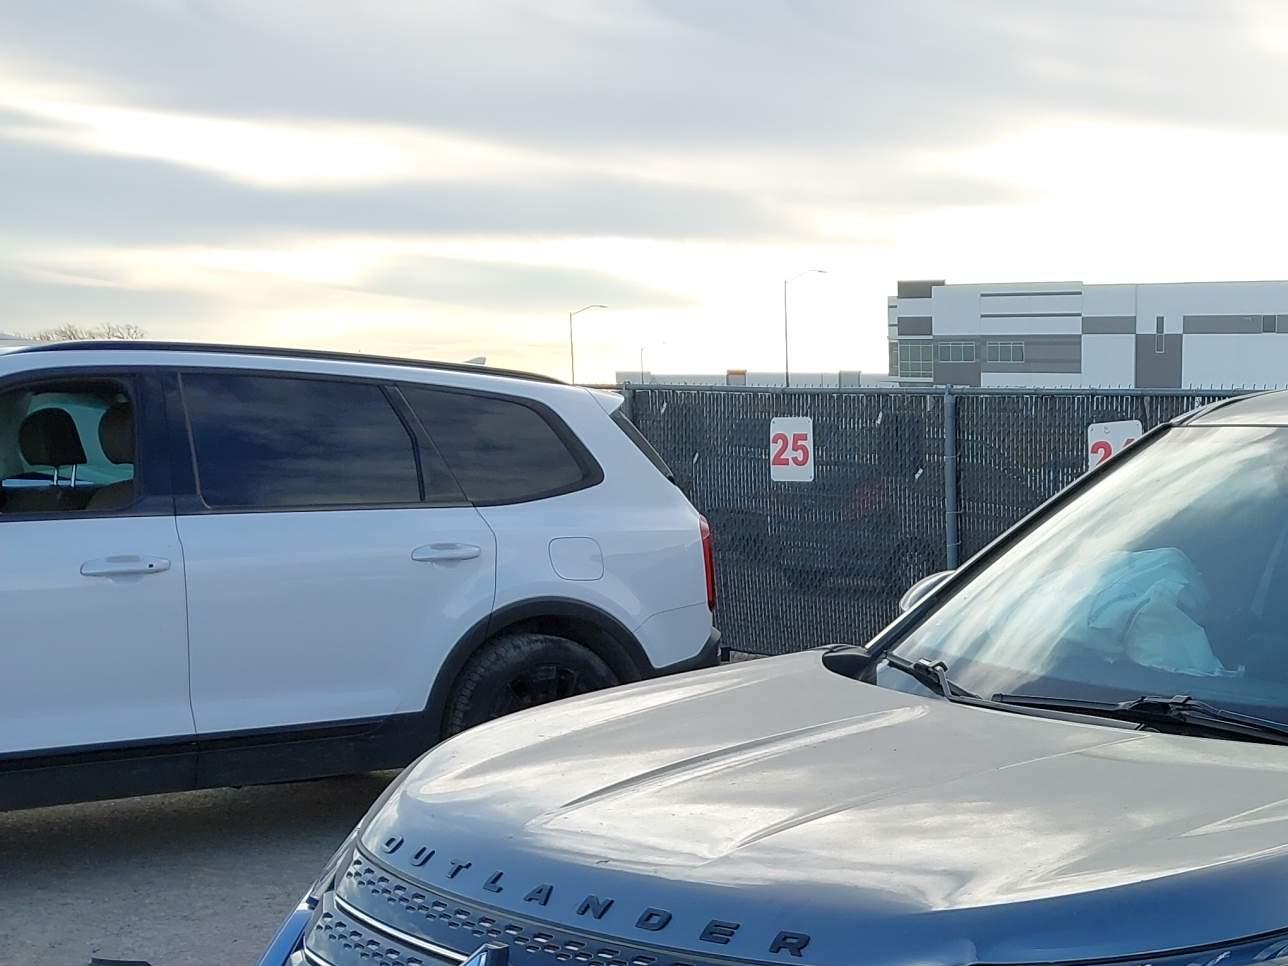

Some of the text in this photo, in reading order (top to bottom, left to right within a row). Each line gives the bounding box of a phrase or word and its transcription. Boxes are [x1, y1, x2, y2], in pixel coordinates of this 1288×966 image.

[771, 433, 809, 467] 25
[1091, 438, 1136, 466] 2
[382, 836, 812, 958] OUTLANDER
